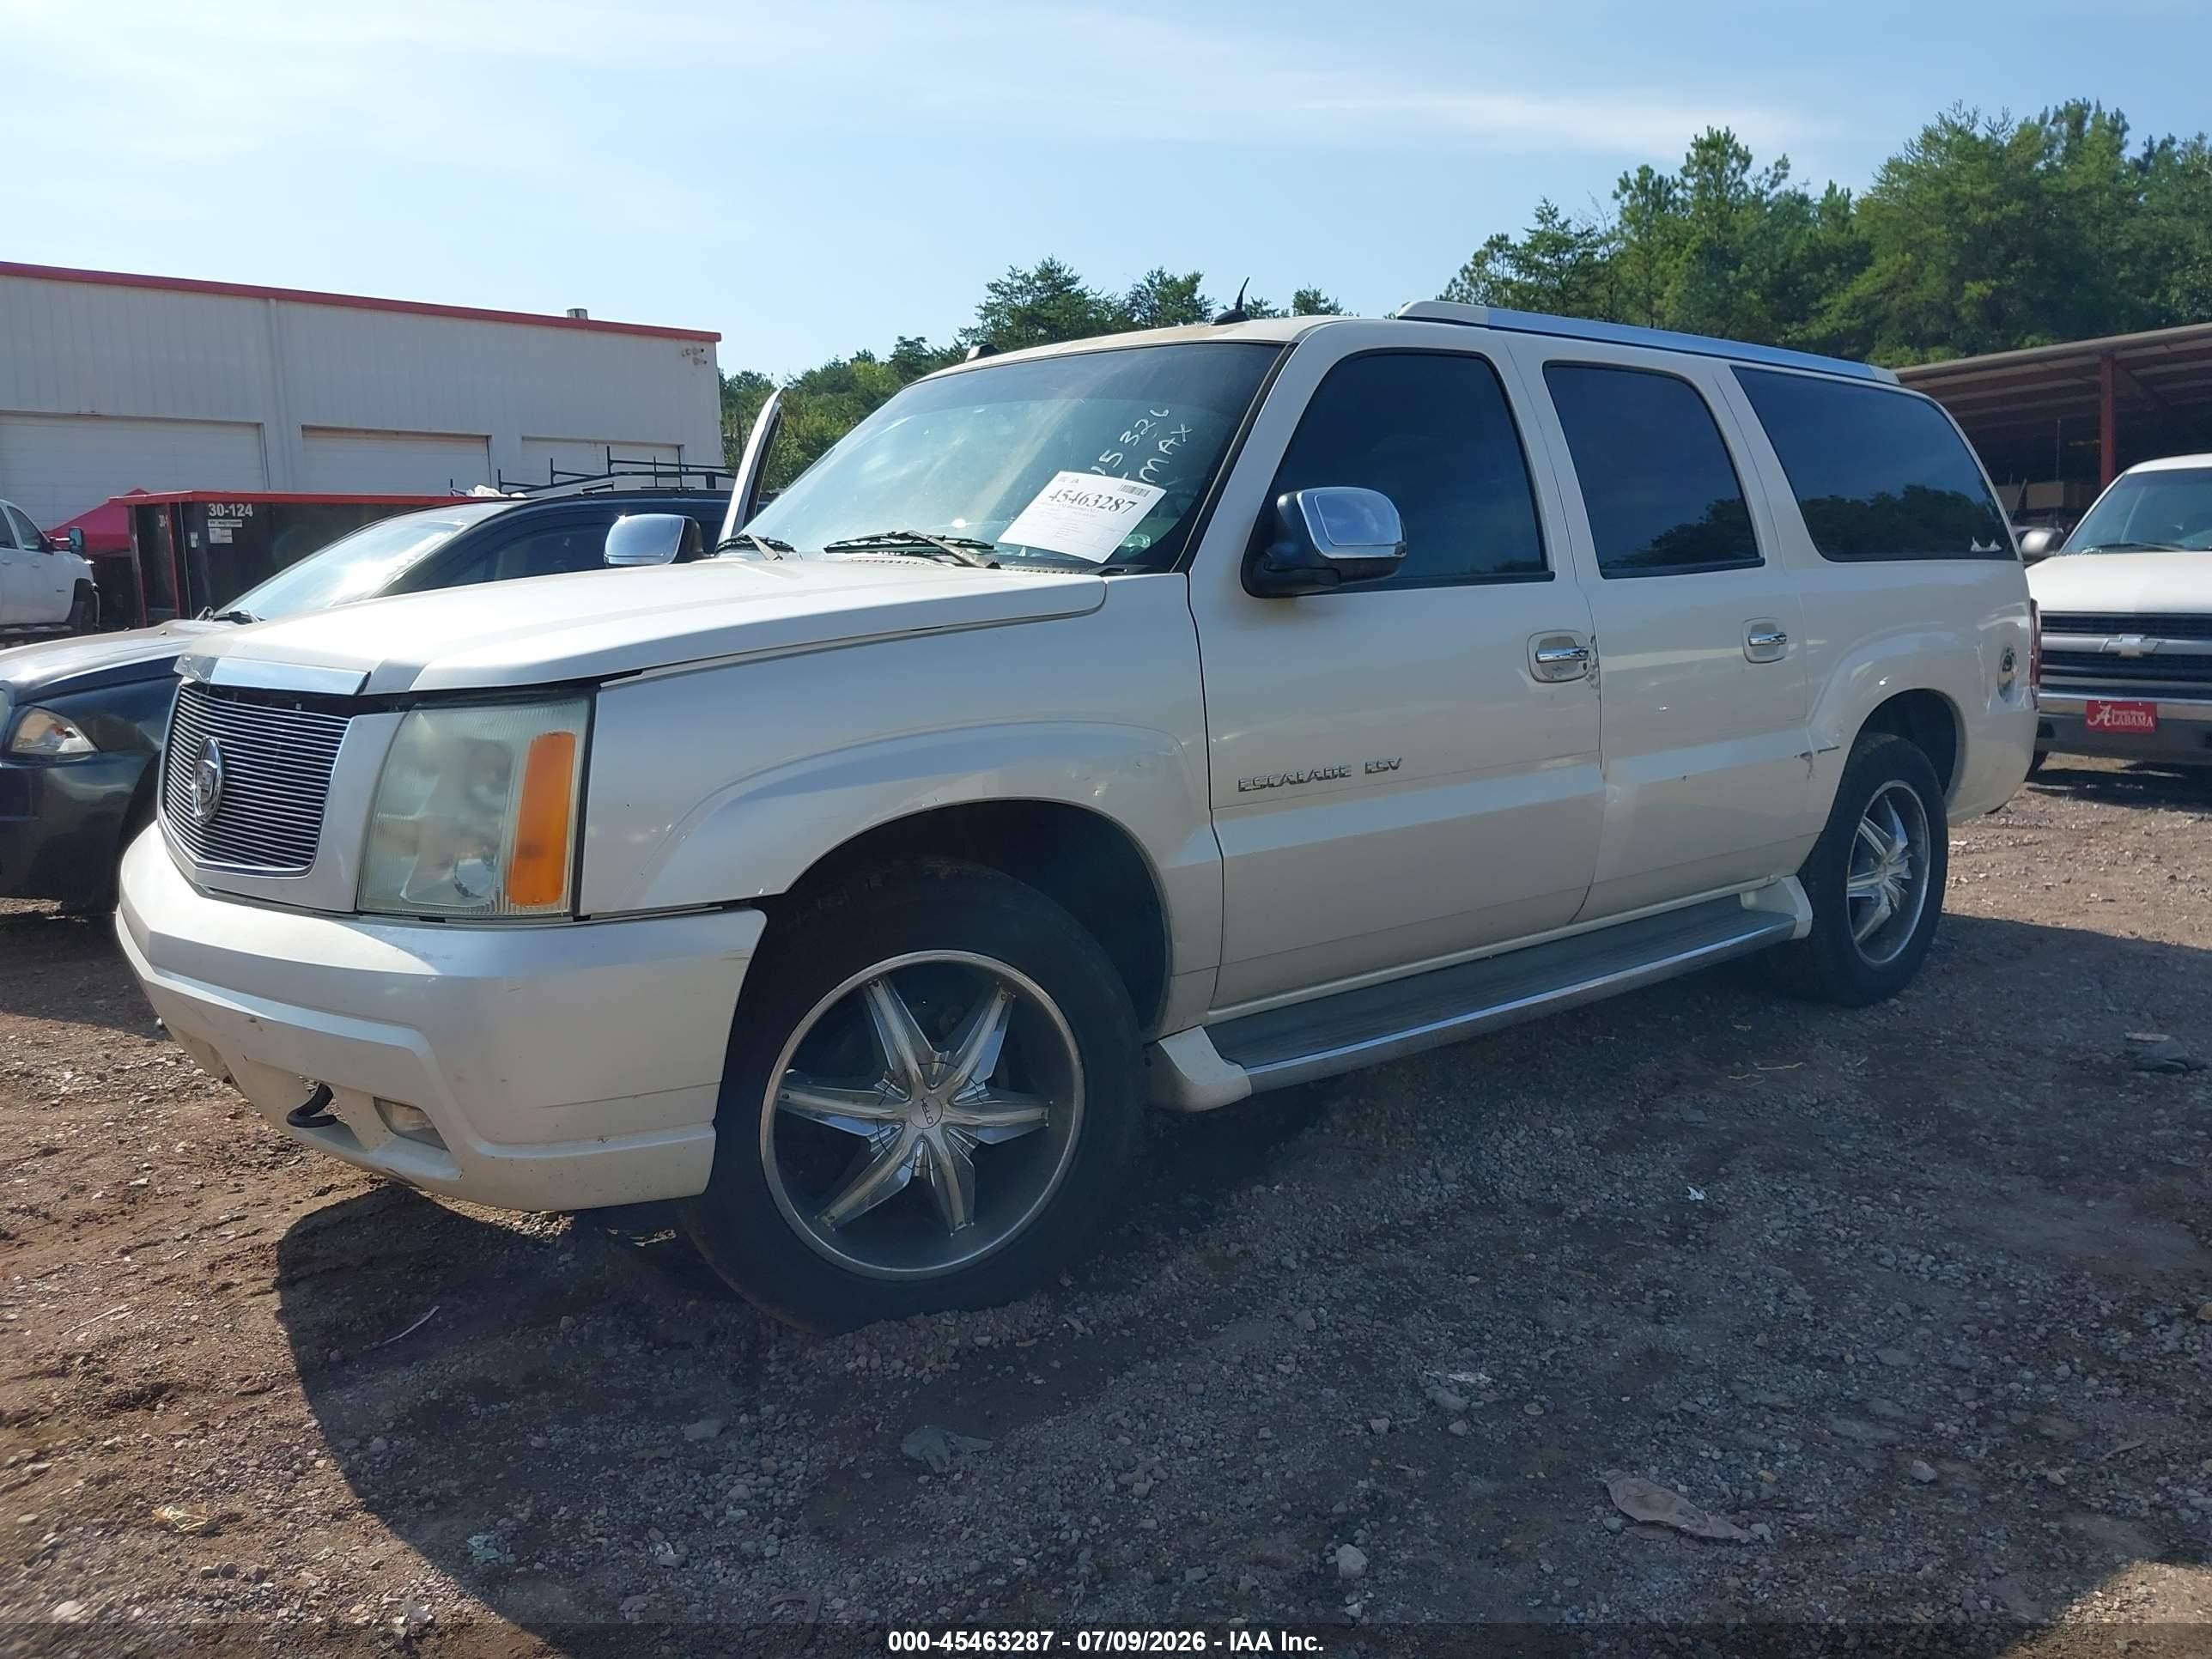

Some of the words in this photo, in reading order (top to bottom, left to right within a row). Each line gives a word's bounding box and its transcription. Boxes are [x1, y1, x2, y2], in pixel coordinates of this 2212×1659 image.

[208, 502, 254, 517] 30-124
[1048, 488, 1139, 515] 45463287
[1237, 765, 1352, 793] ESCALADE
[1364, 756, 1402, 775] ESV
